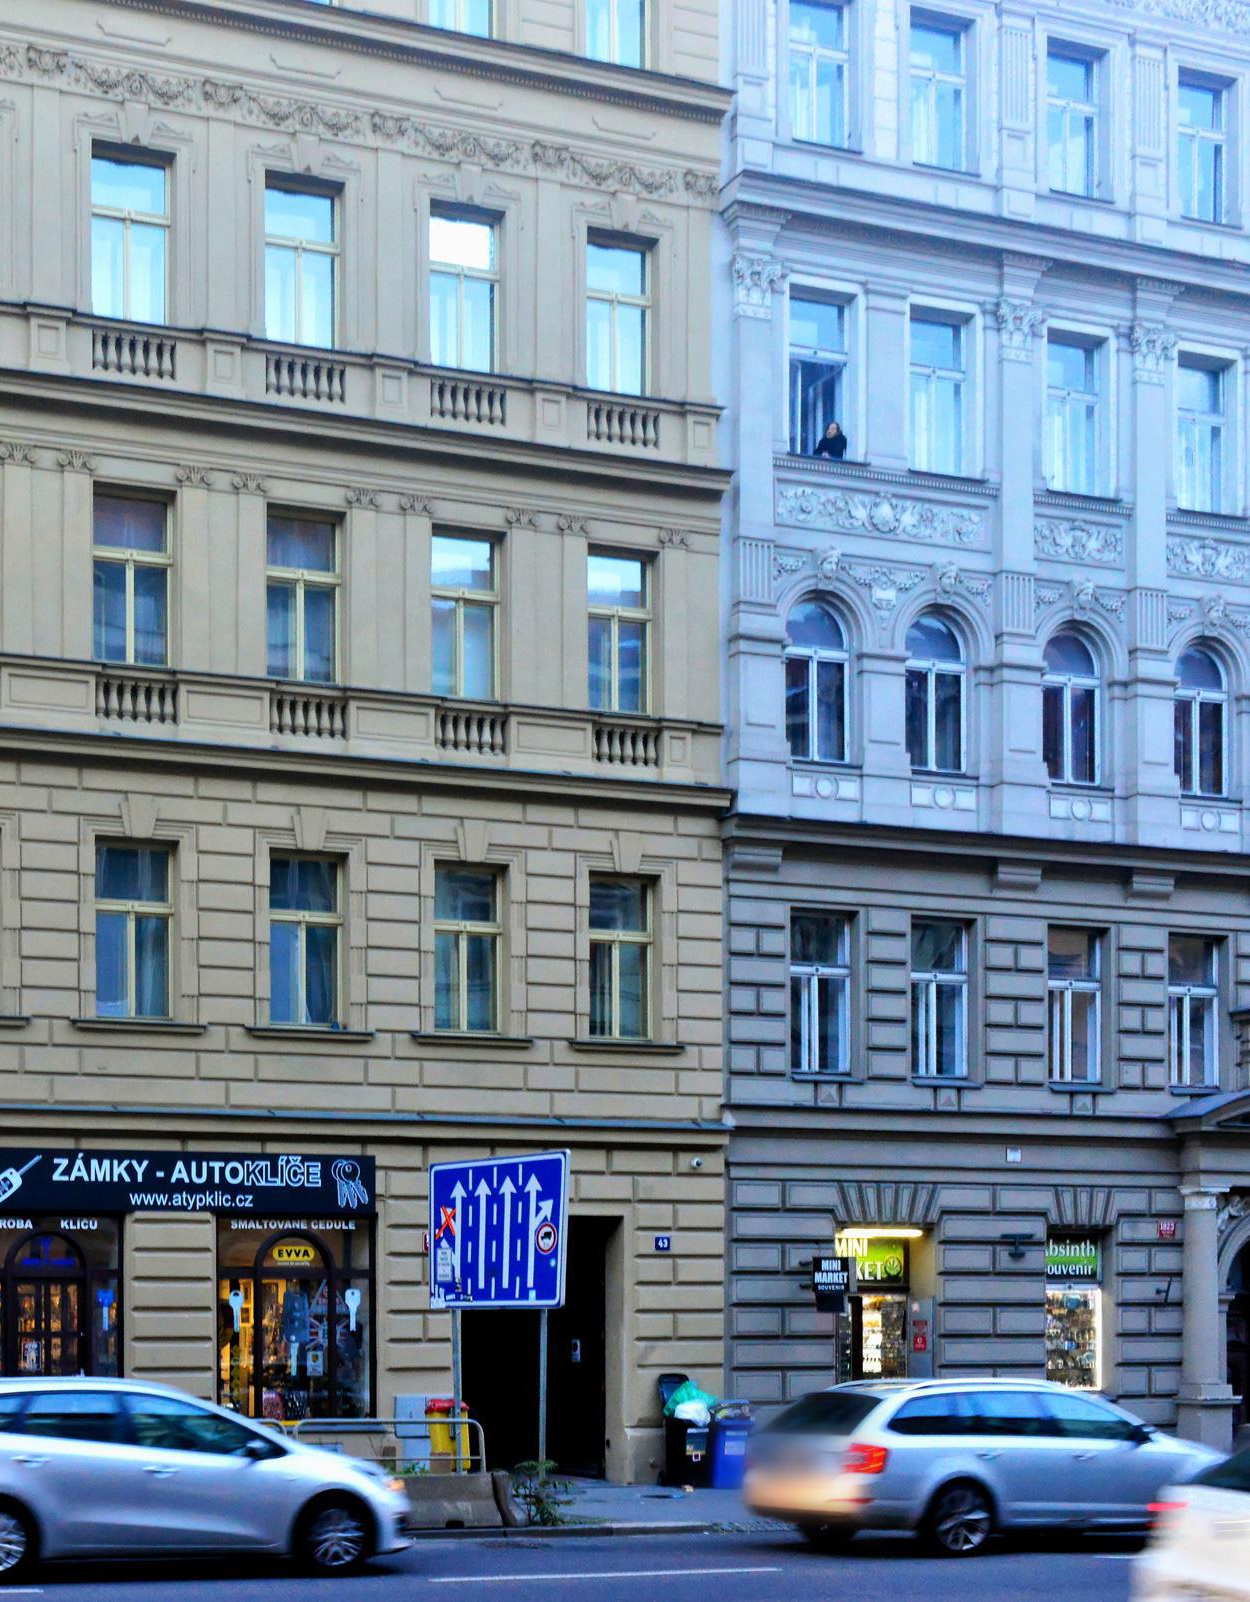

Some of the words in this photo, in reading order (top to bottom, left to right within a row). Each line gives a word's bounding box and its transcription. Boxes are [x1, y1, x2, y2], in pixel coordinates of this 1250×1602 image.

[52, 1152, 149, 1183] ZÁMKY
[170, 1155, 322, 1187] AUTOKLÍČE
[129, 1190, 253, 1210] www.atypklic.cz
[310, 1219, 356, 1230] CEDULE
[658, 1238, 668, 1248] 43
[835, 1238, 868, 1257] MINI
[1046, 1239, 1095, 1257] bsinth
[277, 1249, 310, 1258] EVVA
[821, 1259, 841, 1271] MINI
[855, 1262, 883, 1280] KET
[1047, 1261, 1093, 1275] ouvenir
[814, 1272, 848, 1284] MARKET
